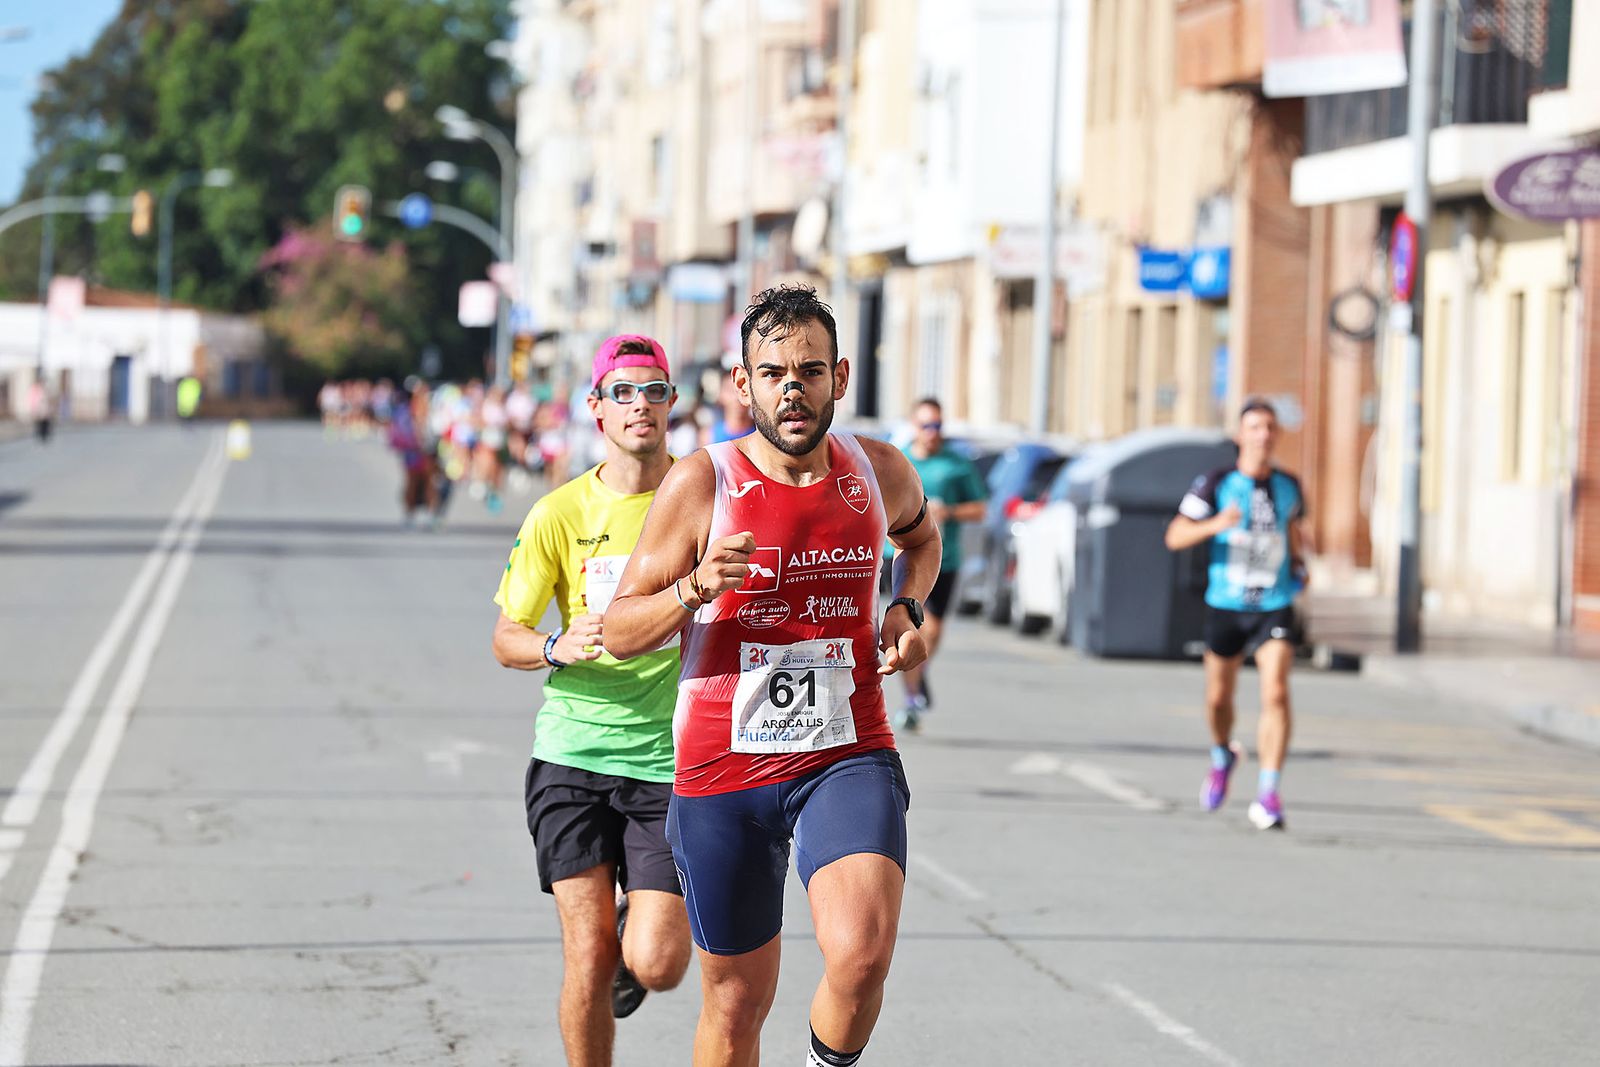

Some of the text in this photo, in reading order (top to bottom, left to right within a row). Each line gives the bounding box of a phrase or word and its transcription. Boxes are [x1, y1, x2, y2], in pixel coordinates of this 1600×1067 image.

[787, 545, 874, 568] ALTACASA
[785, 571, 873, 584] AGENTES INMOBILIARIOS
[820, 596, 854, 607] NUTRI
[768, 605, 788, 613] auto
[819, 606, 859, 618] CLAVERIA
[769, 669, 816, 708] 61
[761, 718, 804, 729] AROCA
[806, 717, 824, 727] LIS
[737, 728, 791, 742] Huelva
